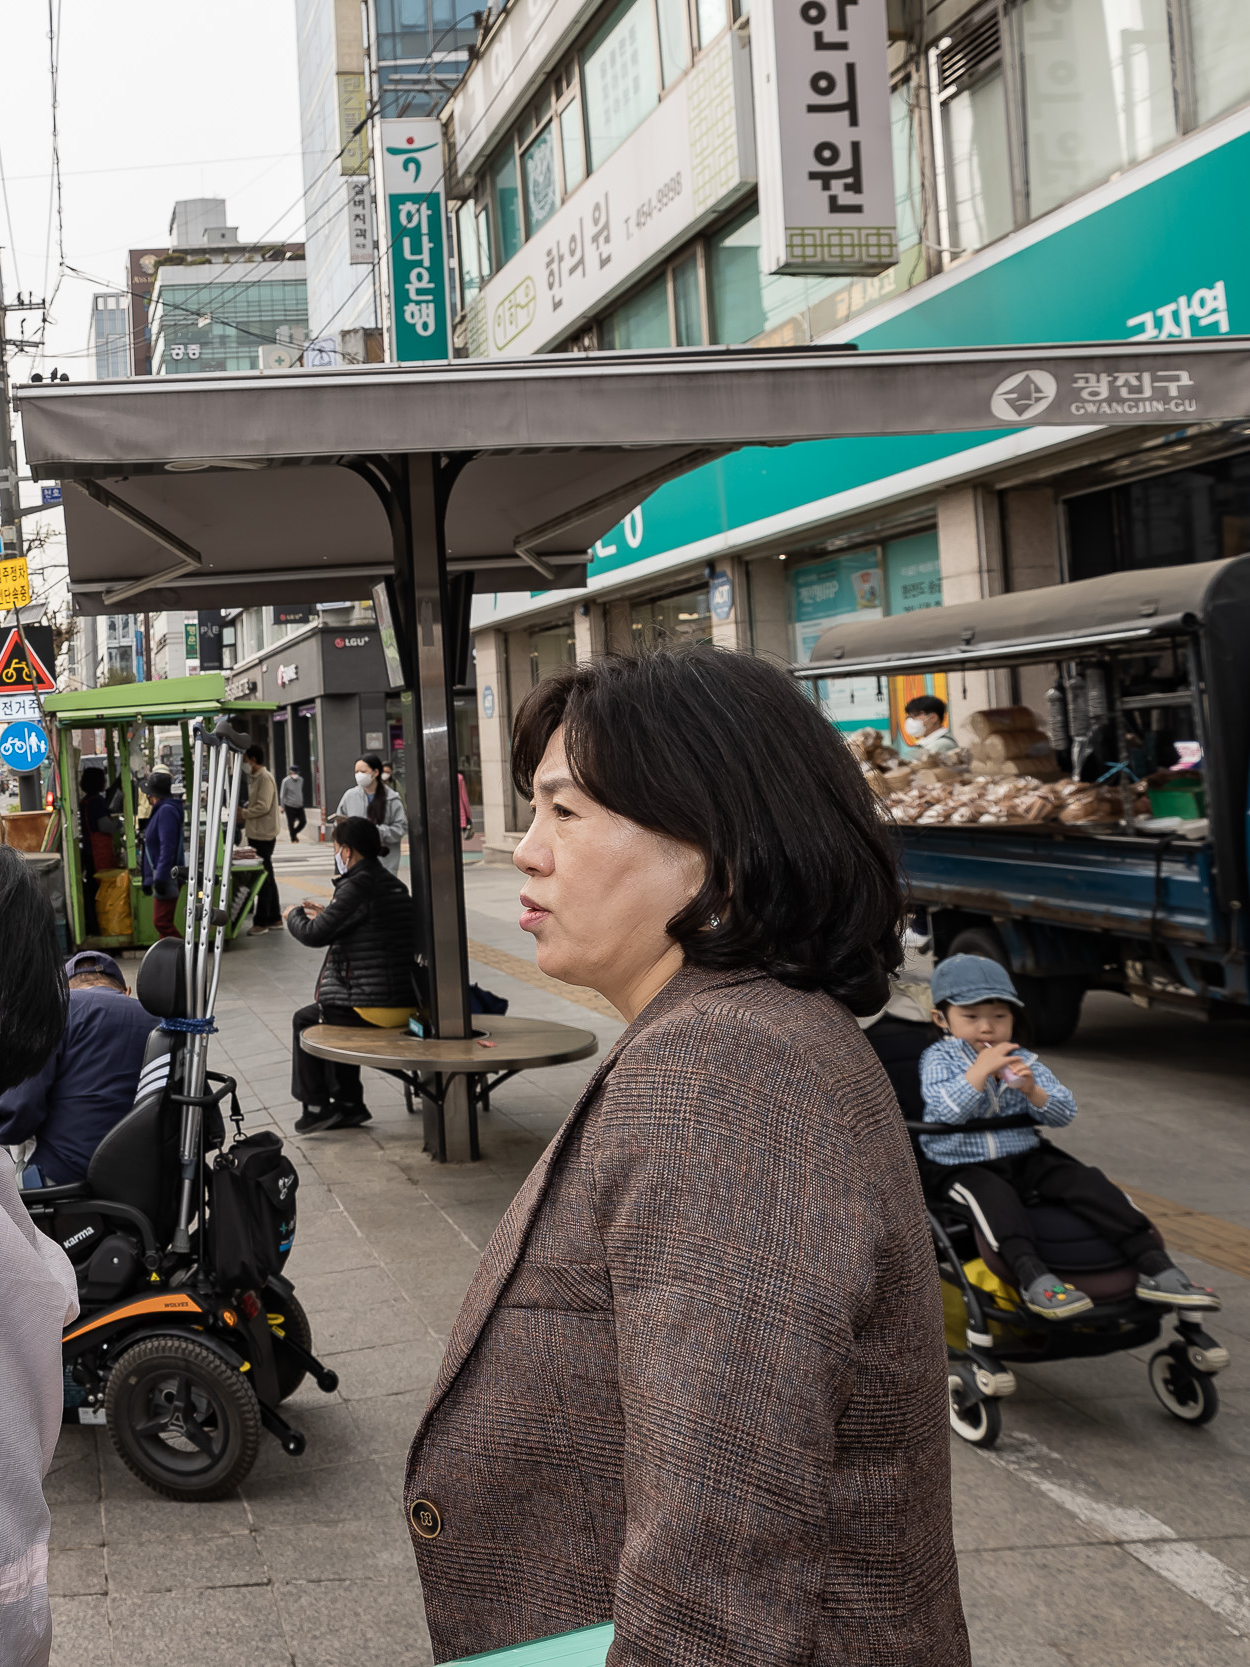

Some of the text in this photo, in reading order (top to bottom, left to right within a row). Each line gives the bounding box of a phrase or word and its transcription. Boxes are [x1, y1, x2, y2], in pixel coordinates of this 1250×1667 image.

[546, 191, 612, 312] 한의원
[397, 201, 436, 337] 하나은행
[1071, 370, 1195, 400] 광진구
[1070, 399, 1197, 416] GWANGJIN-GU
[63, 1225, 95, 1249] karma
